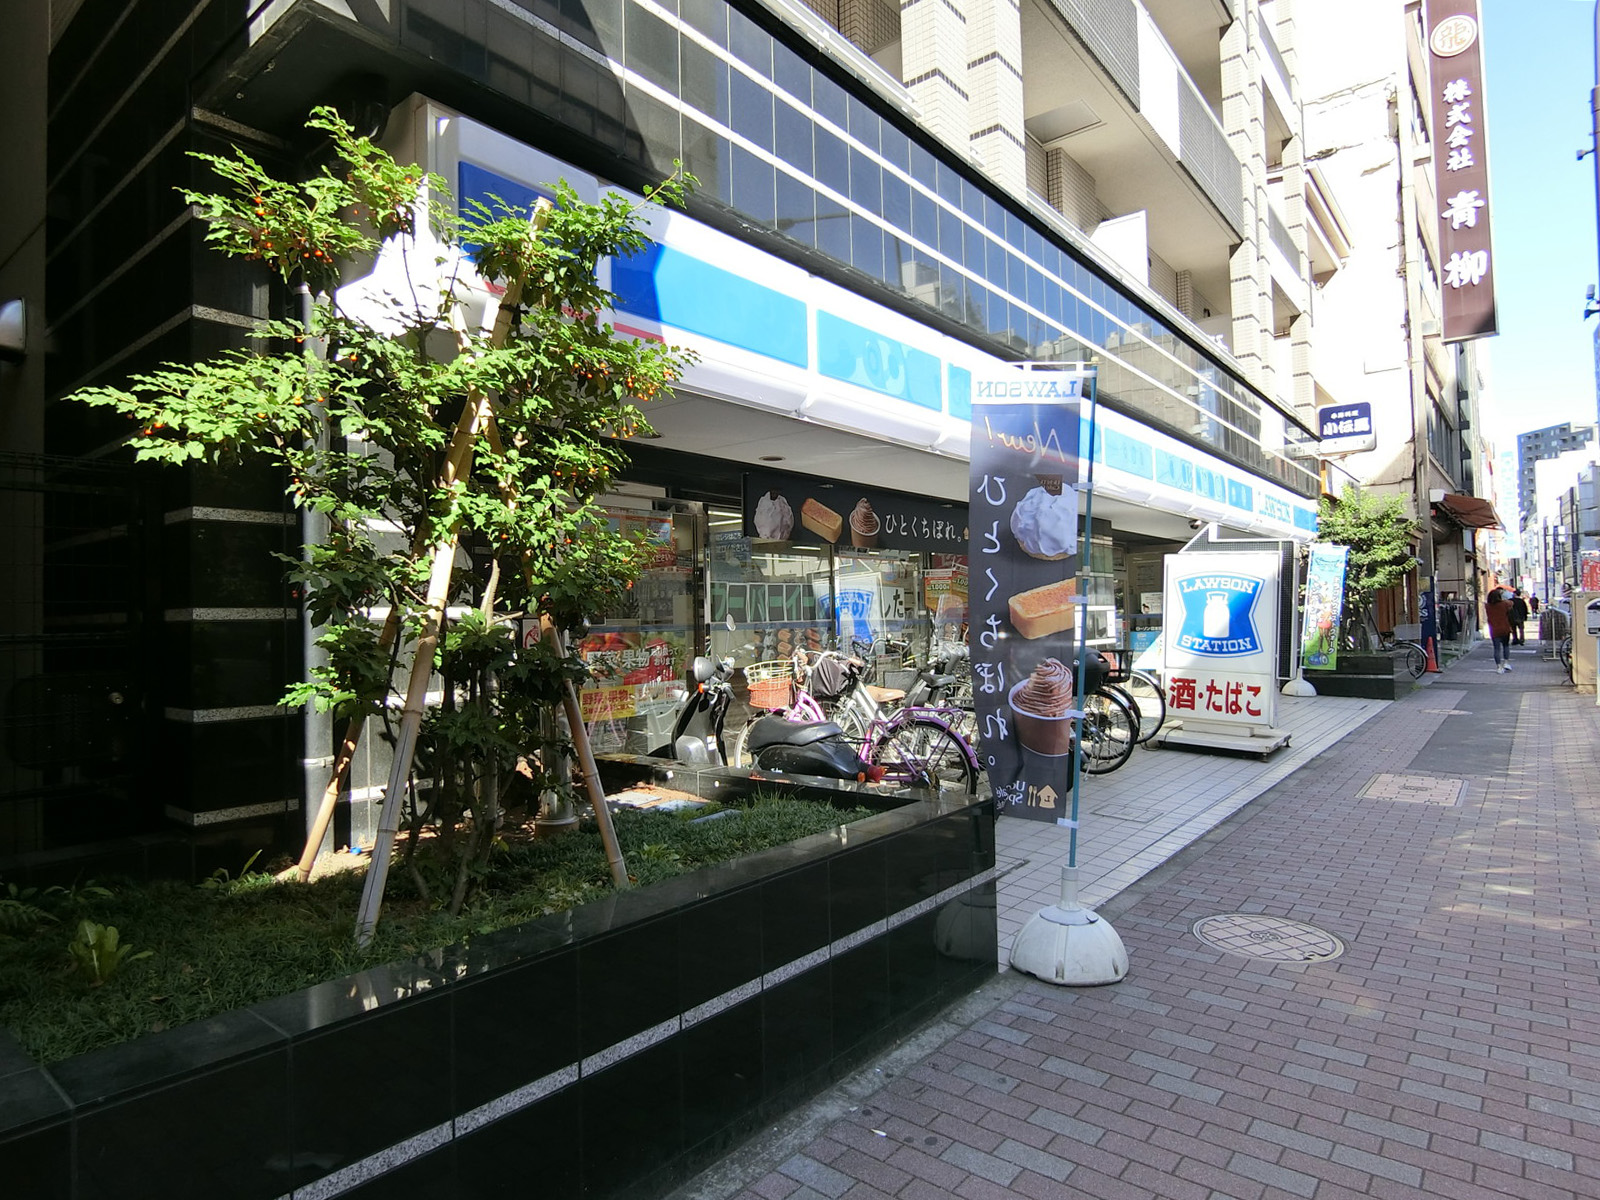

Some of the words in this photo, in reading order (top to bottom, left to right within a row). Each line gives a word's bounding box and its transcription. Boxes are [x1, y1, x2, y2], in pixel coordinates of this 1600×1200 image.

[1443, 78, 1474, 172] 株式会社
[1441, 190, 1487, 289] 青柳
[1181, 576, 1256, 595] LAWSON
[1180, 635, 1253, 653] STATION
[1168, 677, 1262, 717] 酒・たばこ
